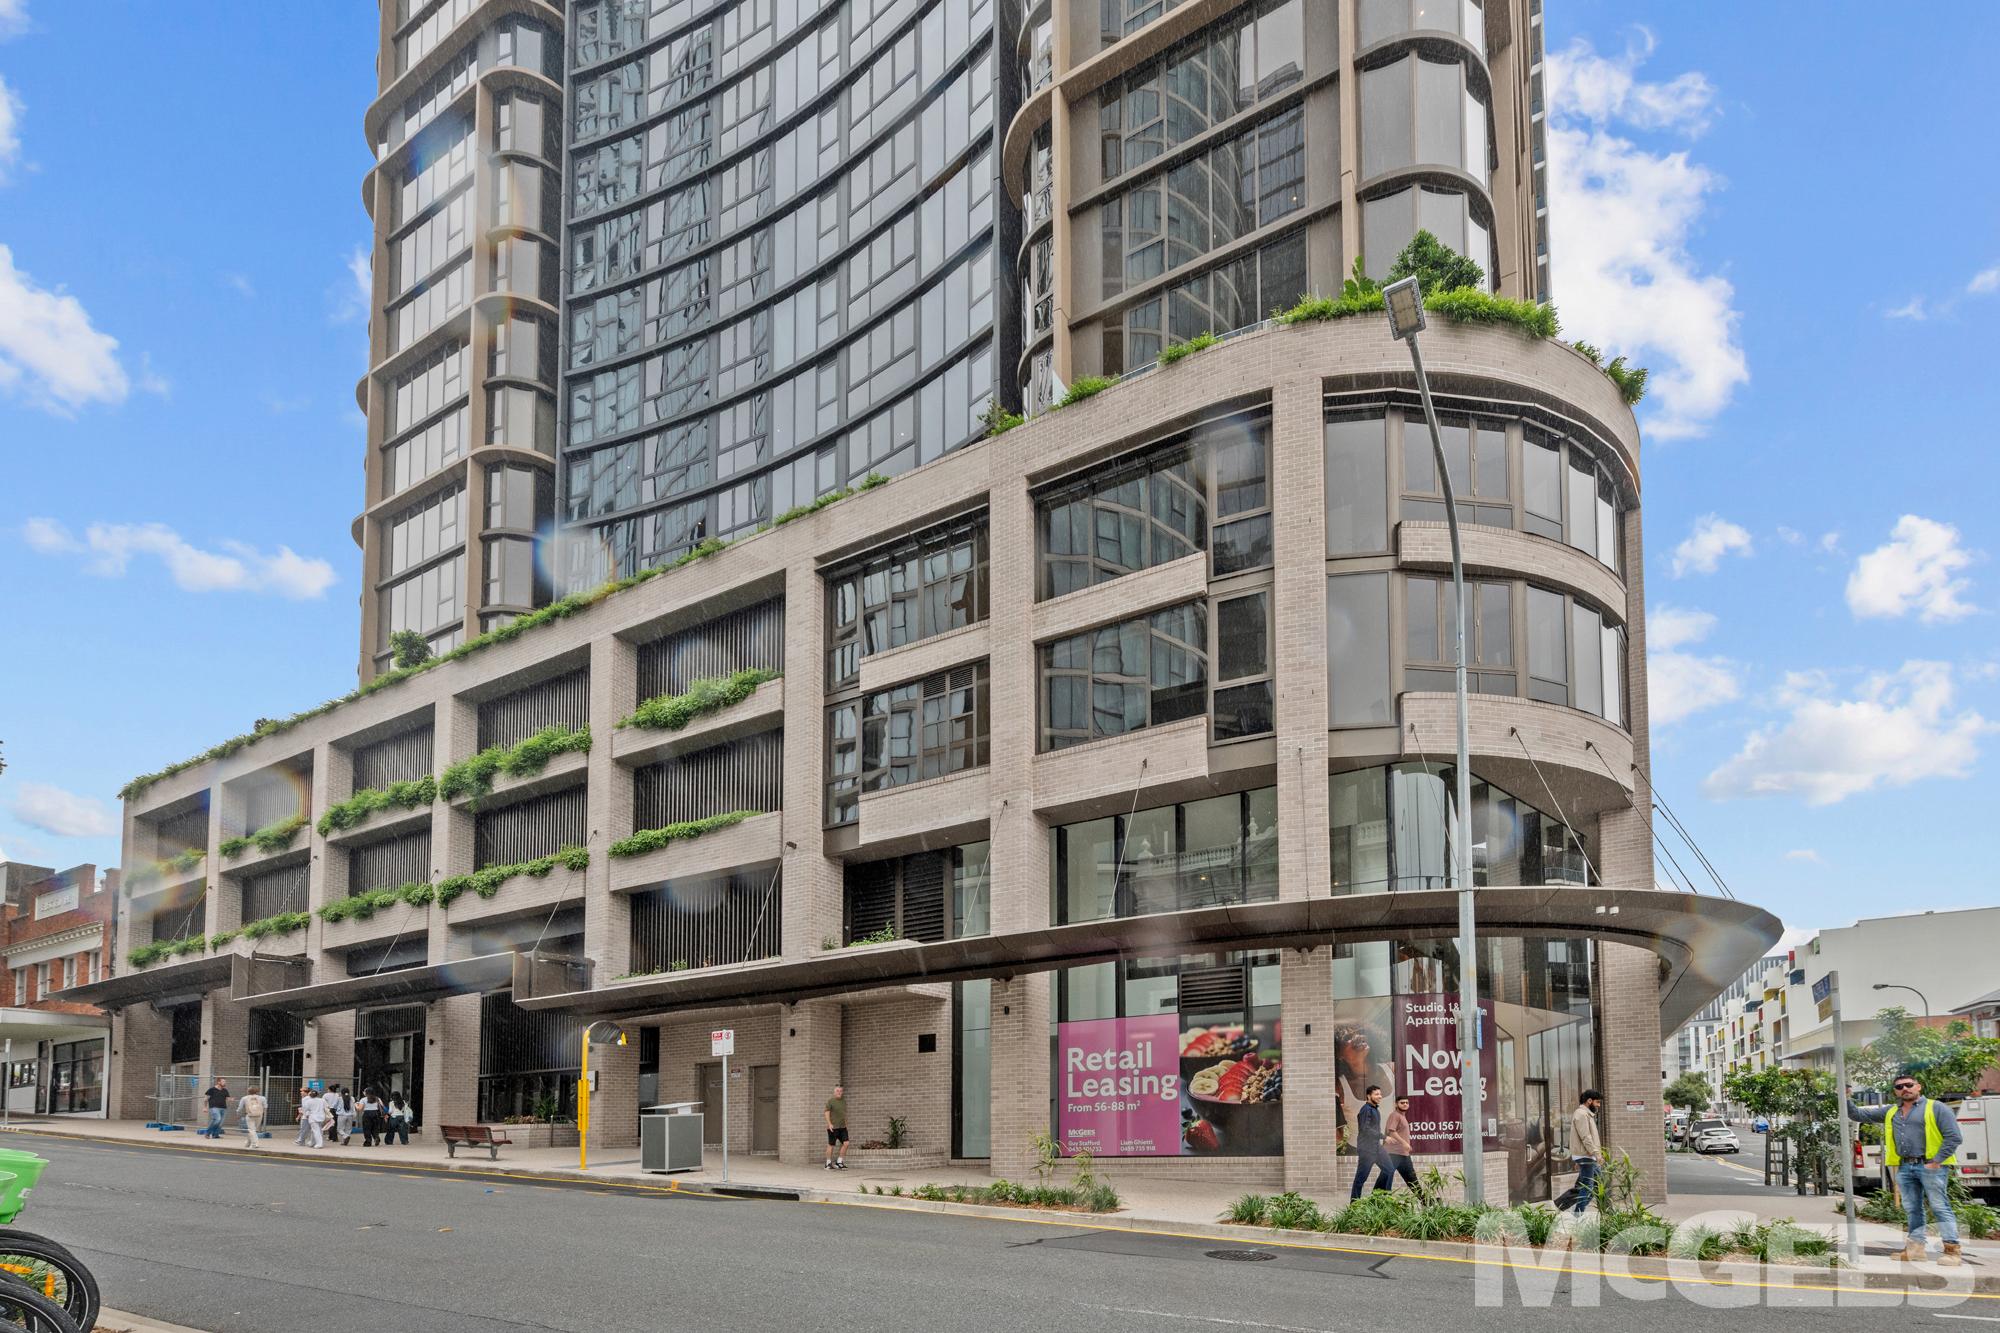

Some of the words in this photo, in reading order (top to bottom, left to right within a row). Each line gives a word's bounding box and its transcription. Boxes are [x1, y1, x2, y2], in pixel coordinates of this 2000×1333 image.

[1068, 1041, 1152, 1072] Retail
[1068, 1069, 1177, 1100] Leasing
[1068, 1103, 1092, 1112] From
[1095, 1101, 1125, 1112] 56-88
[1409, 1121, 1436, 1131] 1300
[1438, 1121, 1454, 1131] 156
